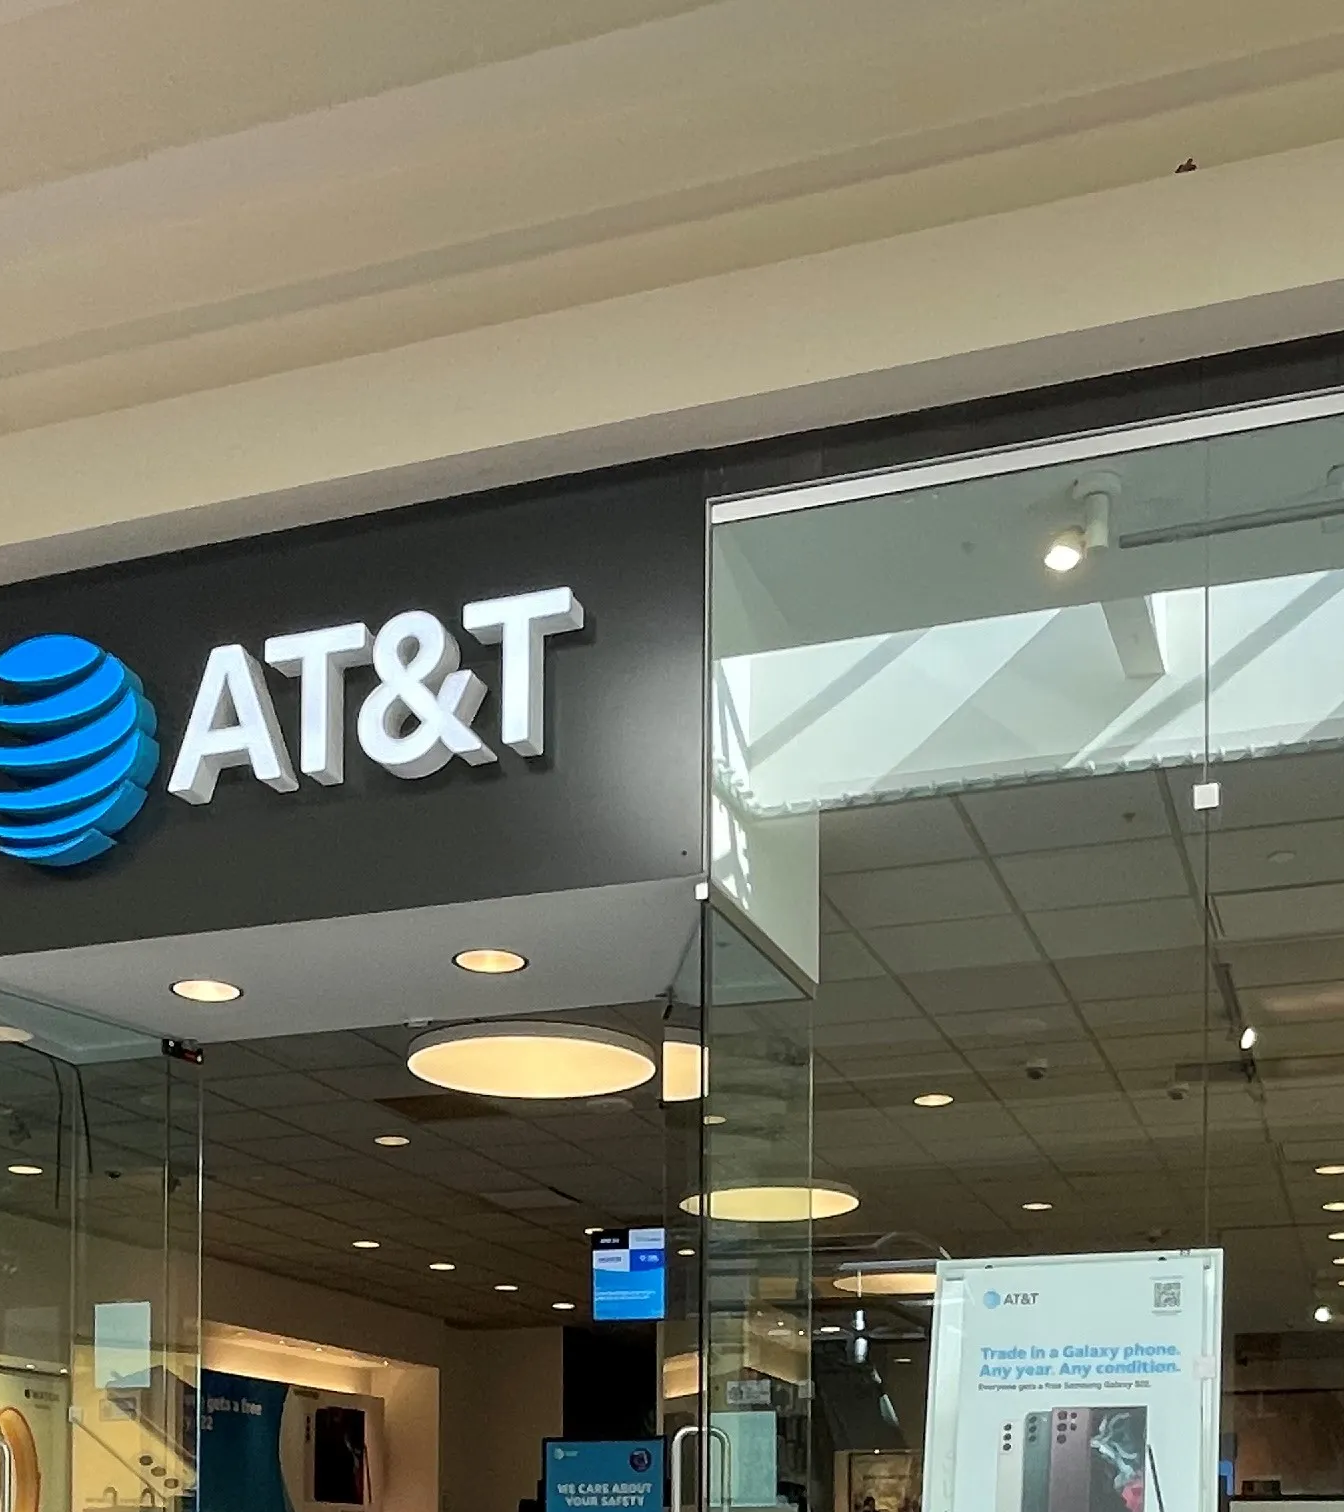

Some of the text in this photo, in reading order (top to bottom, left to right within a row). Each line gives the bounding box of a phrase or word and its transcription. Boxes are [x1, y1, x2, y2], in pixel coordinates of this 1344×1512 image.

[167, 586, 584, 806] AT&T
[1004, 1293, 1039, 1306] AT&T
[981, 1343, 1181, 1361] Trade in a Galaxy phone.
[979, 1361, 1182, 1380] Any year. Any condition.
